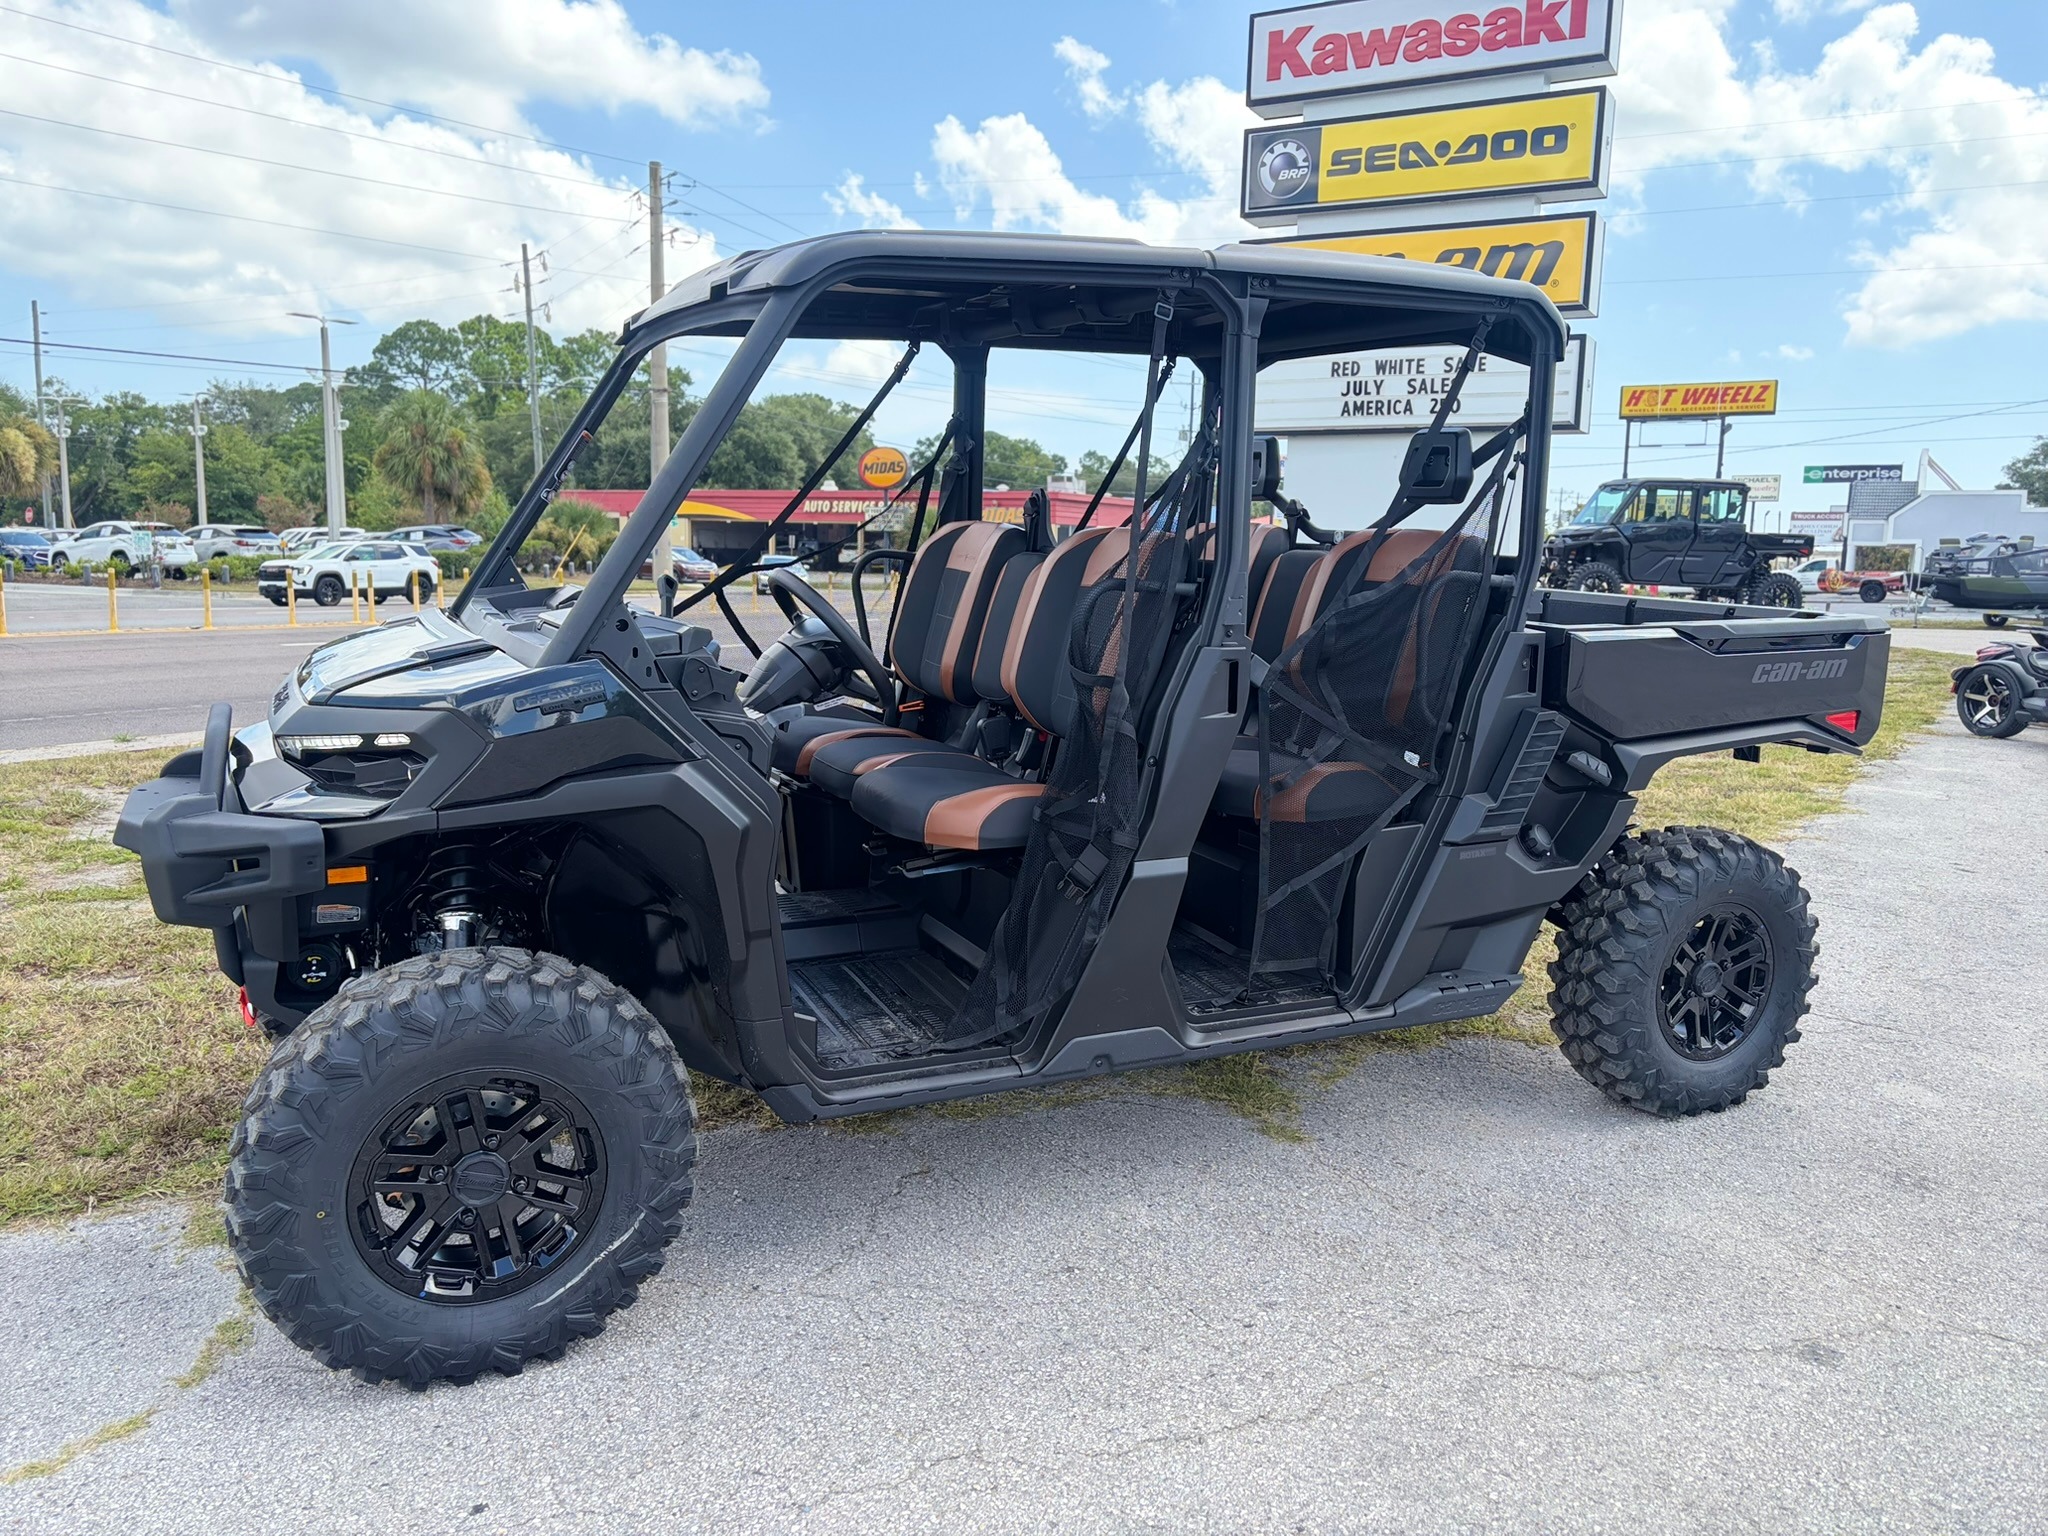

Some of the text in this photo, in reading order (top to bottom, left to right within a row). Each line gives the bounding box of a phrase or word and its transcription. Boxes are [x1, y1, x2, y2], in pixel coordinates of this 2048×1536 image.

[1266, 0, 1589, 82] Kawasaki
[1278, 167, 1309, 182] BRP
[1331, 356, 1487, 378] RED WHITE SAE
[1341, 379, 1384, 397] JULY
[1680, 384, 1771, 406] WHEELZ
[1341, 399, 1413, 417] AMERICA
[863, 461, 905, 476] MIDAS
[1808, 467, 1901, 480] enterprise
[803, 501, 831, 513] AUTO
[832, 500, 877, 514] SERVICE
[1751, 658, 1848, 684] can-am
[515, 680, 604, 709] DEFENDER
[543, 703, 565, 712] LONE
